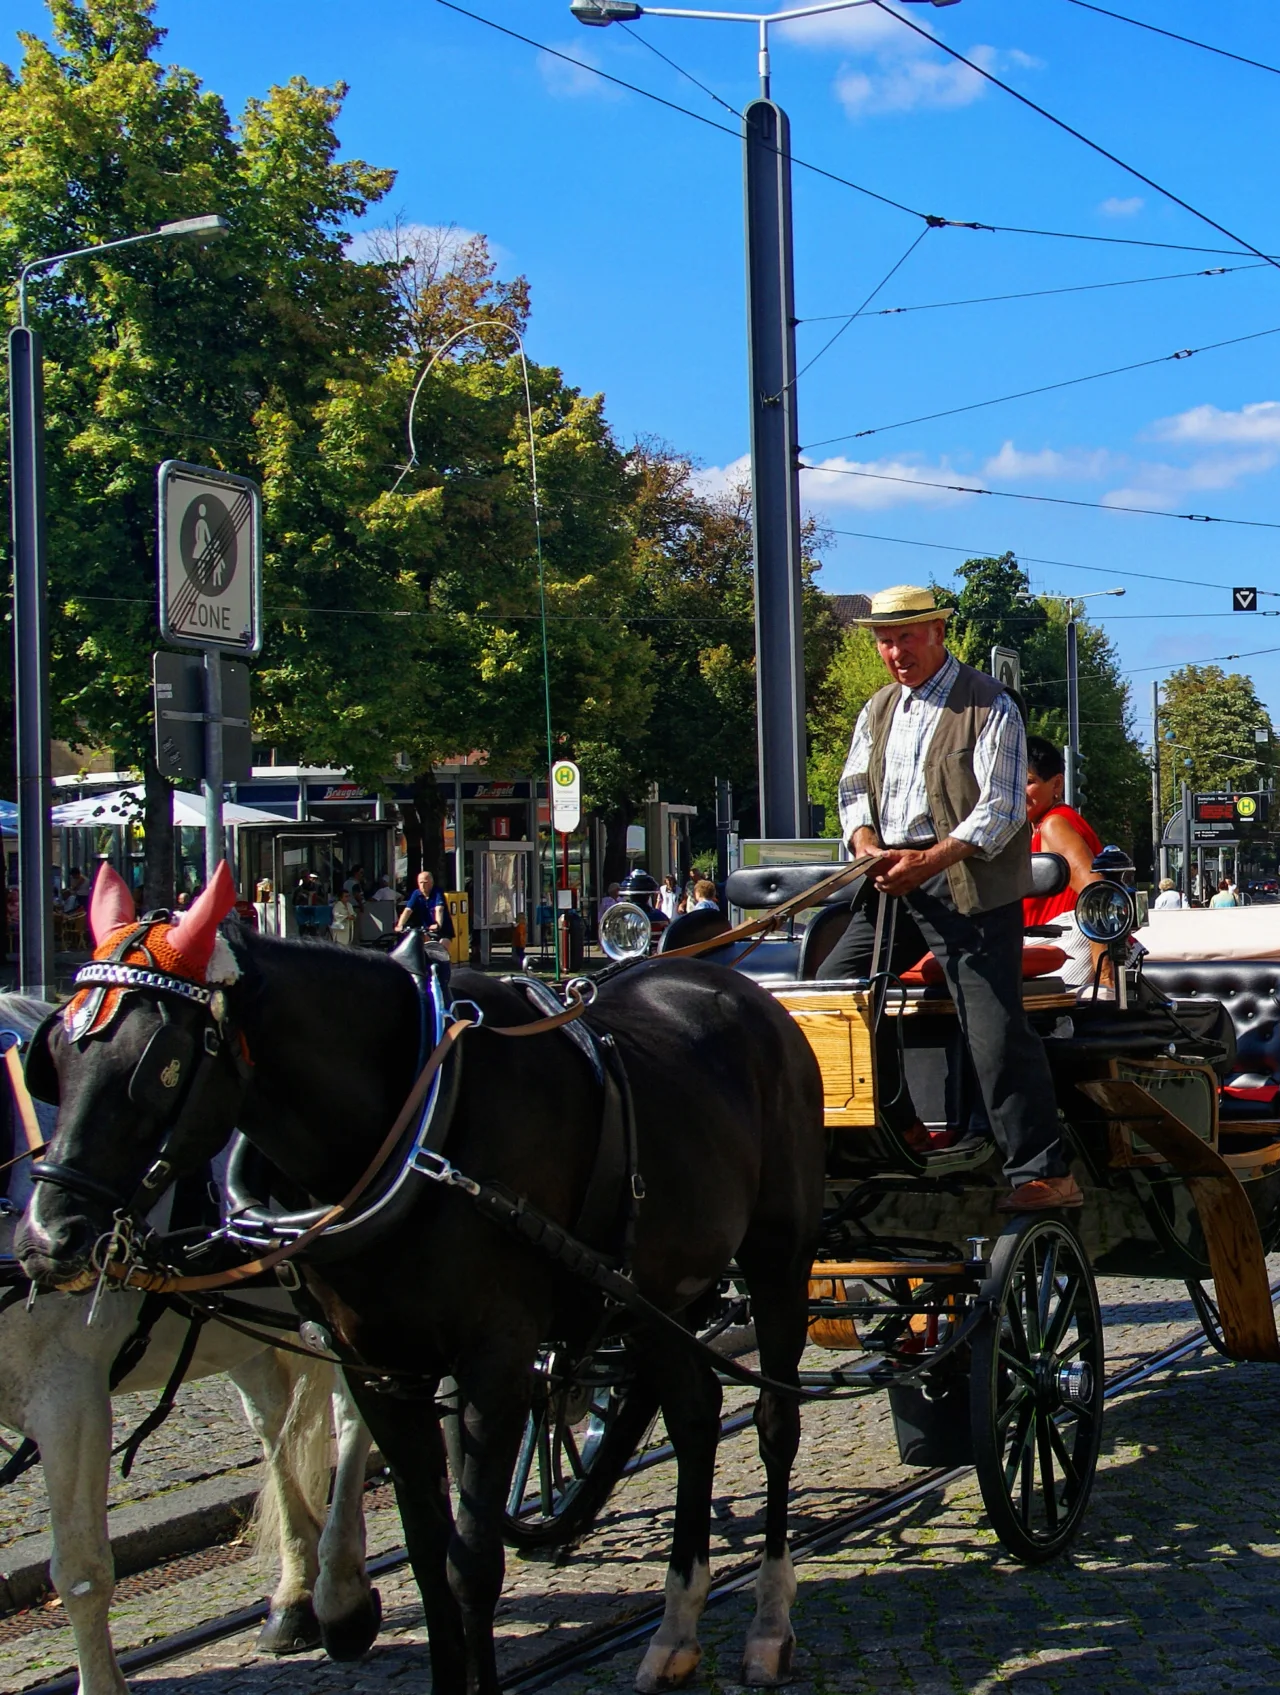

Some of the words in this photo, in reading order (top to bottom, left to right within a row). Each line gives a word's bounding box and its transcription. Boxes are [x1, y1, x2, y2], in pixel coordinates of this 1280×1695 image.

[187, 602, 231, 631] ZONE
[560, 771, 569, 782] H
[323, 786, 366, 799] Braugold
[1242, 801, 1251, 811] H
